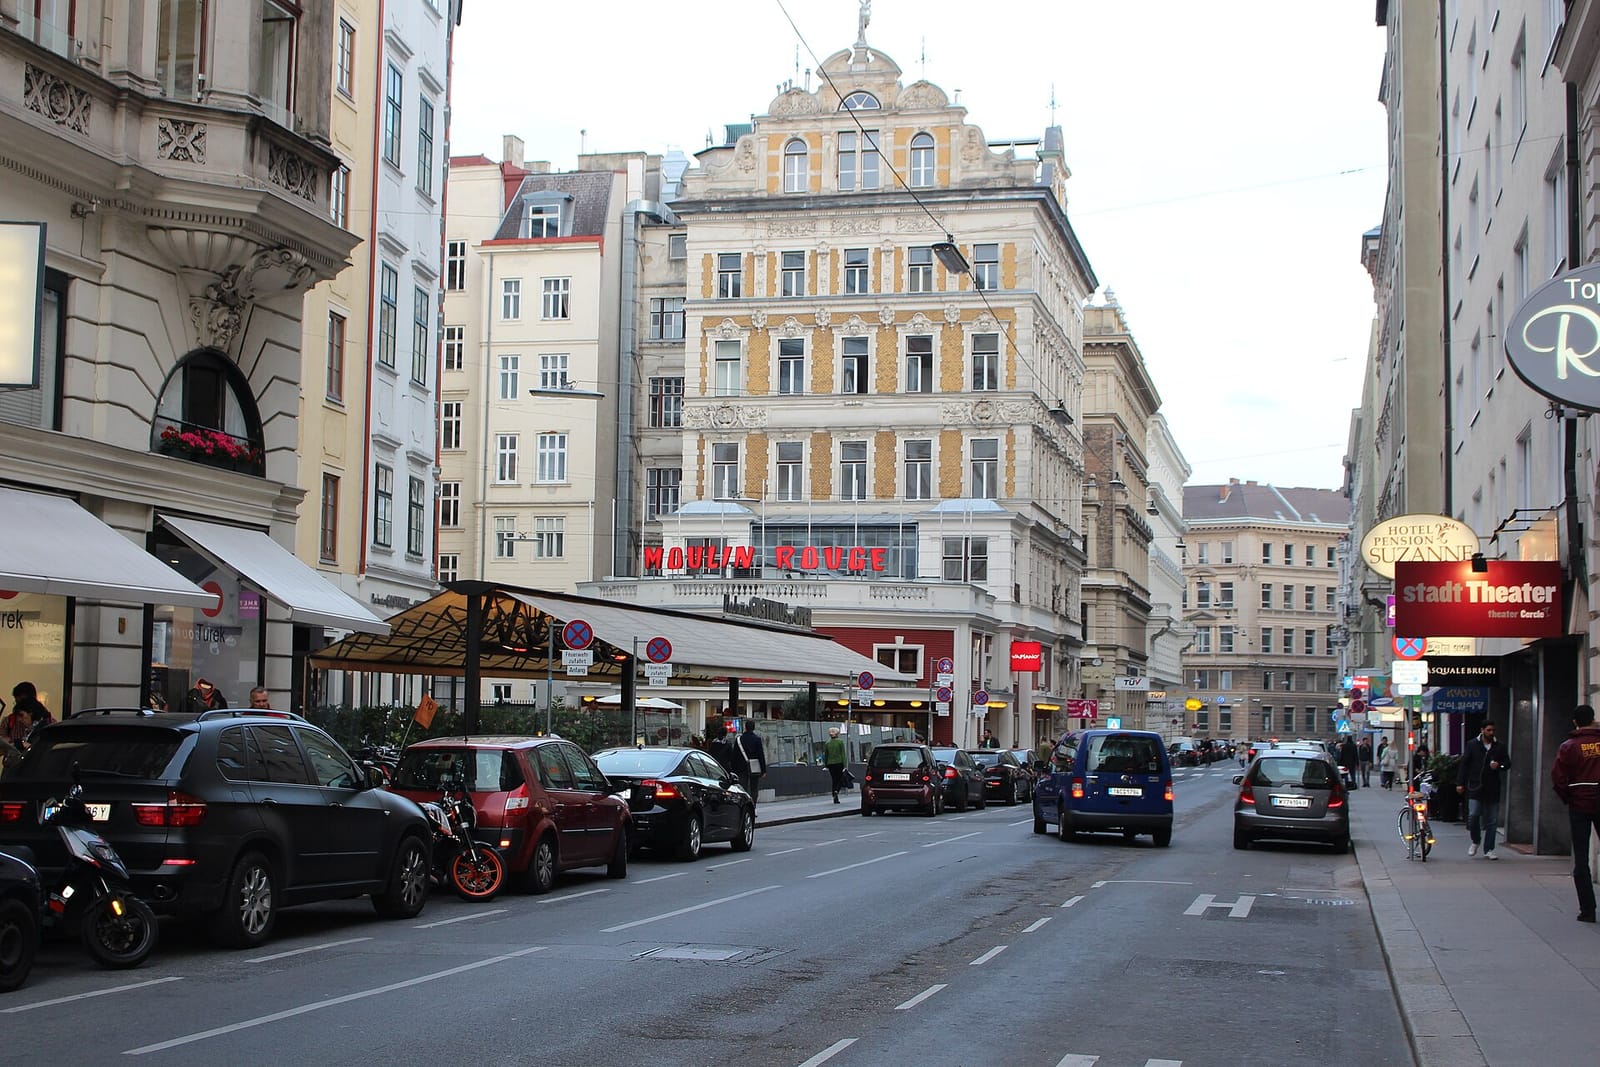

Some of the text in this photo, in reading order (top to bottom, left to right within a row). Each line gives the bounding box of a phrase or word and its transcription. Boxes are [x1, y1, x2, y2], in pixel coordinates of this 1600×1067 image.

[1563, 279, 1600, 305] To
[1388, 525, 1434, 536] HOTEL
[1374, 536, 1434, 547] PENSION
[644, 546, 886, 571] MOULIN ROUGE
[1369, 545, 1473, 564] SUZANNE
[1403, 580, 1557, 604] stadt Theater
[1488, 609, 1519, 619] theater
[197, 623, 226, 643] Turek
[1466, 667, 1496, 675] BRUNI
[1123, 678, 1142, 686] TÜV
